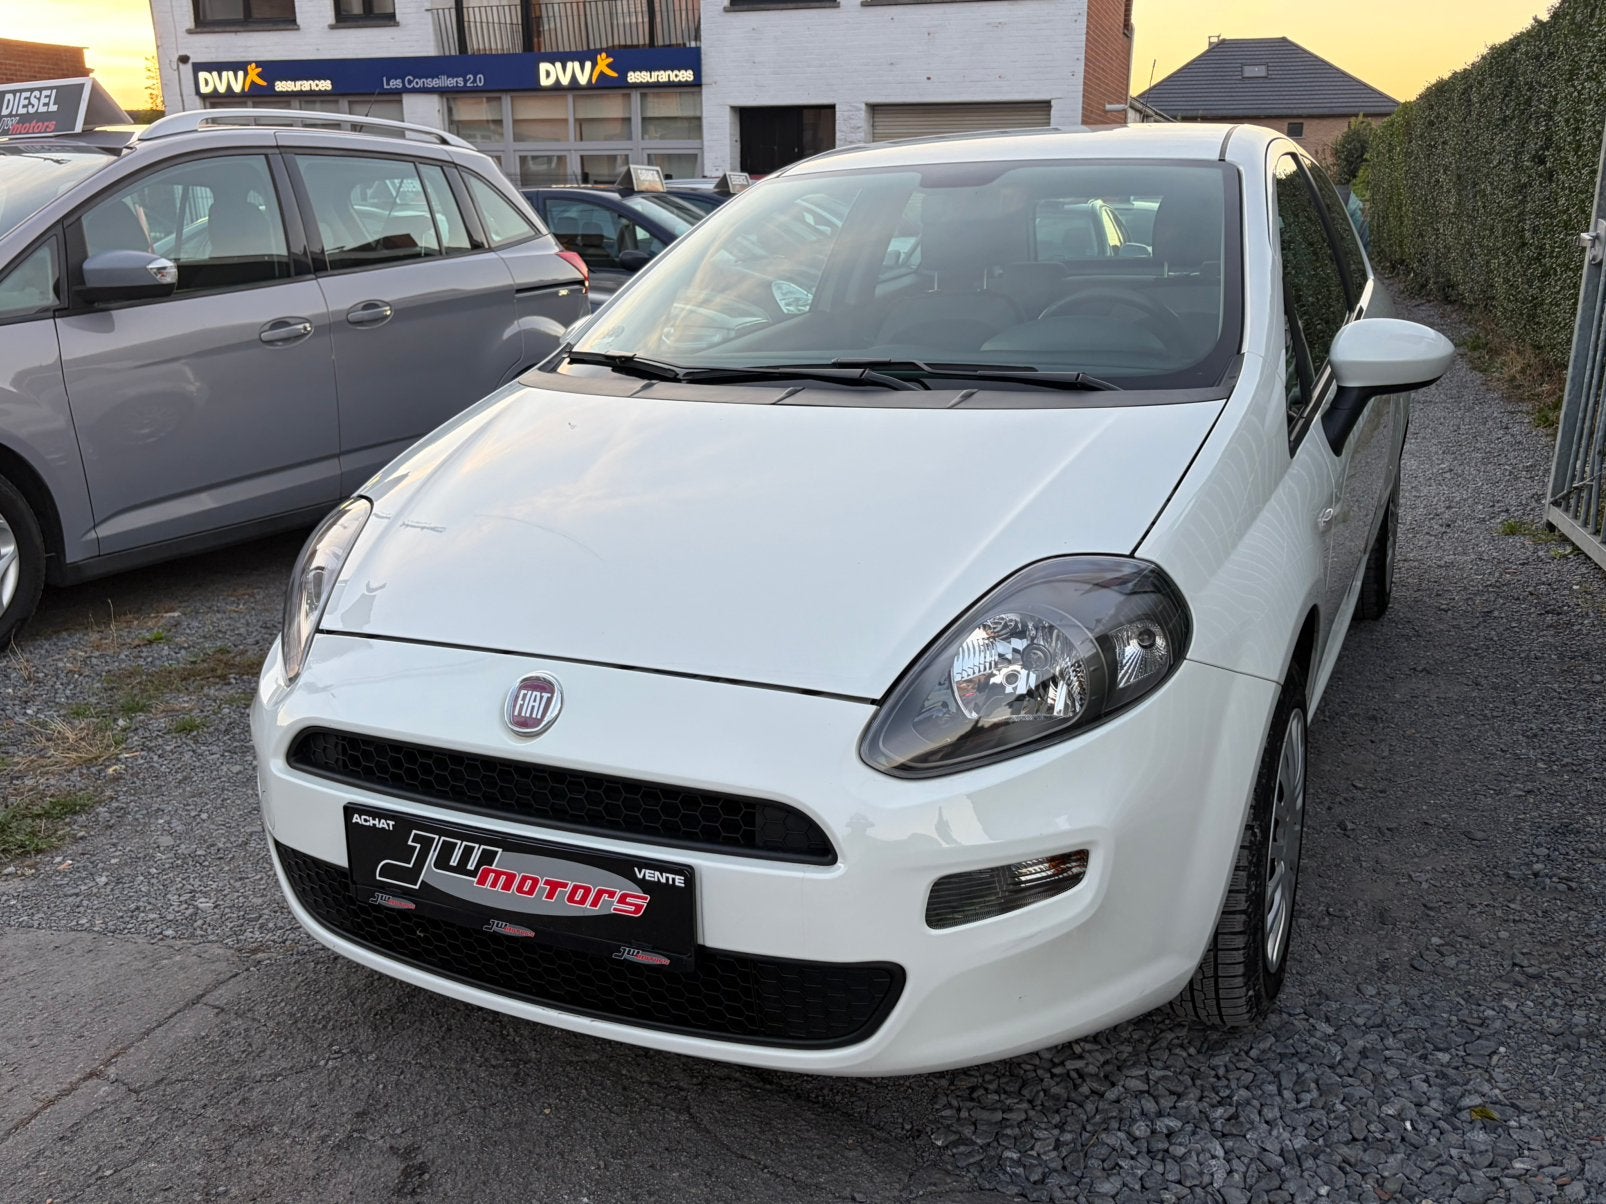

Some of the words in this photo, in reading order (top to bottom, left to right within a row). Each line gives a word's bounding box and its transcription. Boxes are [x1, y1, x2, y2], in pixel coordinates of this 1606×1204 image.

[198, 71, 244, 93] DVV
[275, 80, 332, 92] assurances
[383, 76, 402, 89] Les
[405, 75, 464, 88] Conseillers
[466, 74, 484, 87] 2.0
[539, 60, 592, 86] DVV
[627, 69, 694, 83] assurances
[1, 89, 58, 115] DIESEL
[9, 120, 56, 134] motors
[514, 690, 551, 719] FIAT
[352, 814, 395, 830] ACHAT
[376, 830, 502, 889] JW
[634, 867, 685, 887] VENTE
